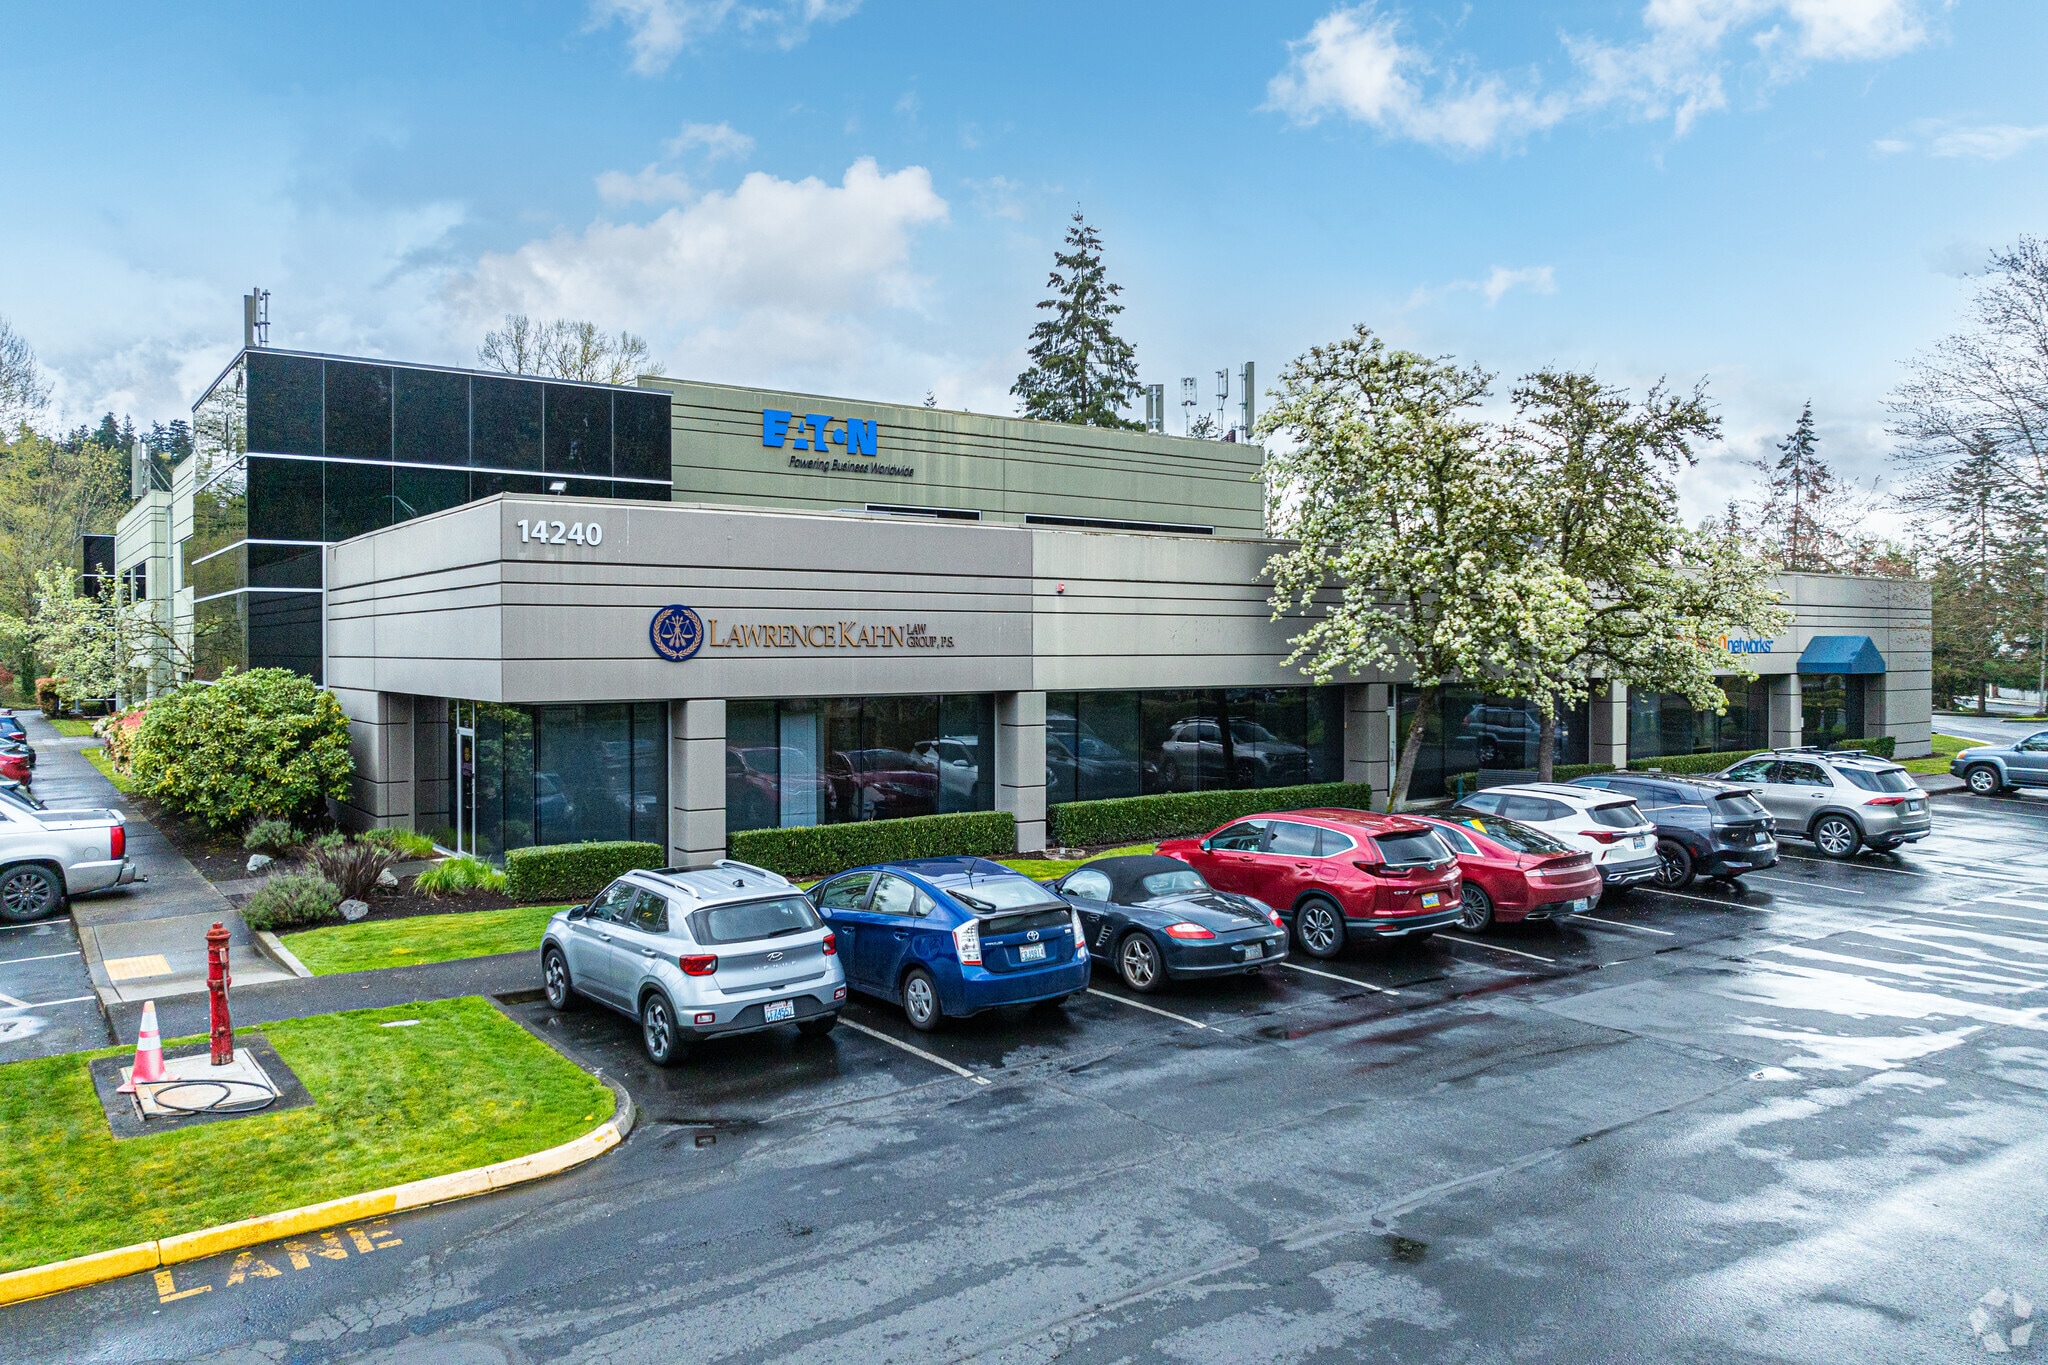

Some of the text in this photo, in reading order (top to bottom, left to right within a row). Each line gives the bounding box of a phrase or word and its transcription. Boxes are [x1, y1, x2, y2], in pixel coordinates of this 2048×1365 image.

[763, 409, 877, 456] EATON
[789, 456, 914, 477] Powering Business Worldwide
[517, 519, 602, 546] 14240
[708, 619, 904, 647] LAWRENCE KAHN
[907, 624, 926, 635] LAW
[153, 1219, 403, 1304] LANE
